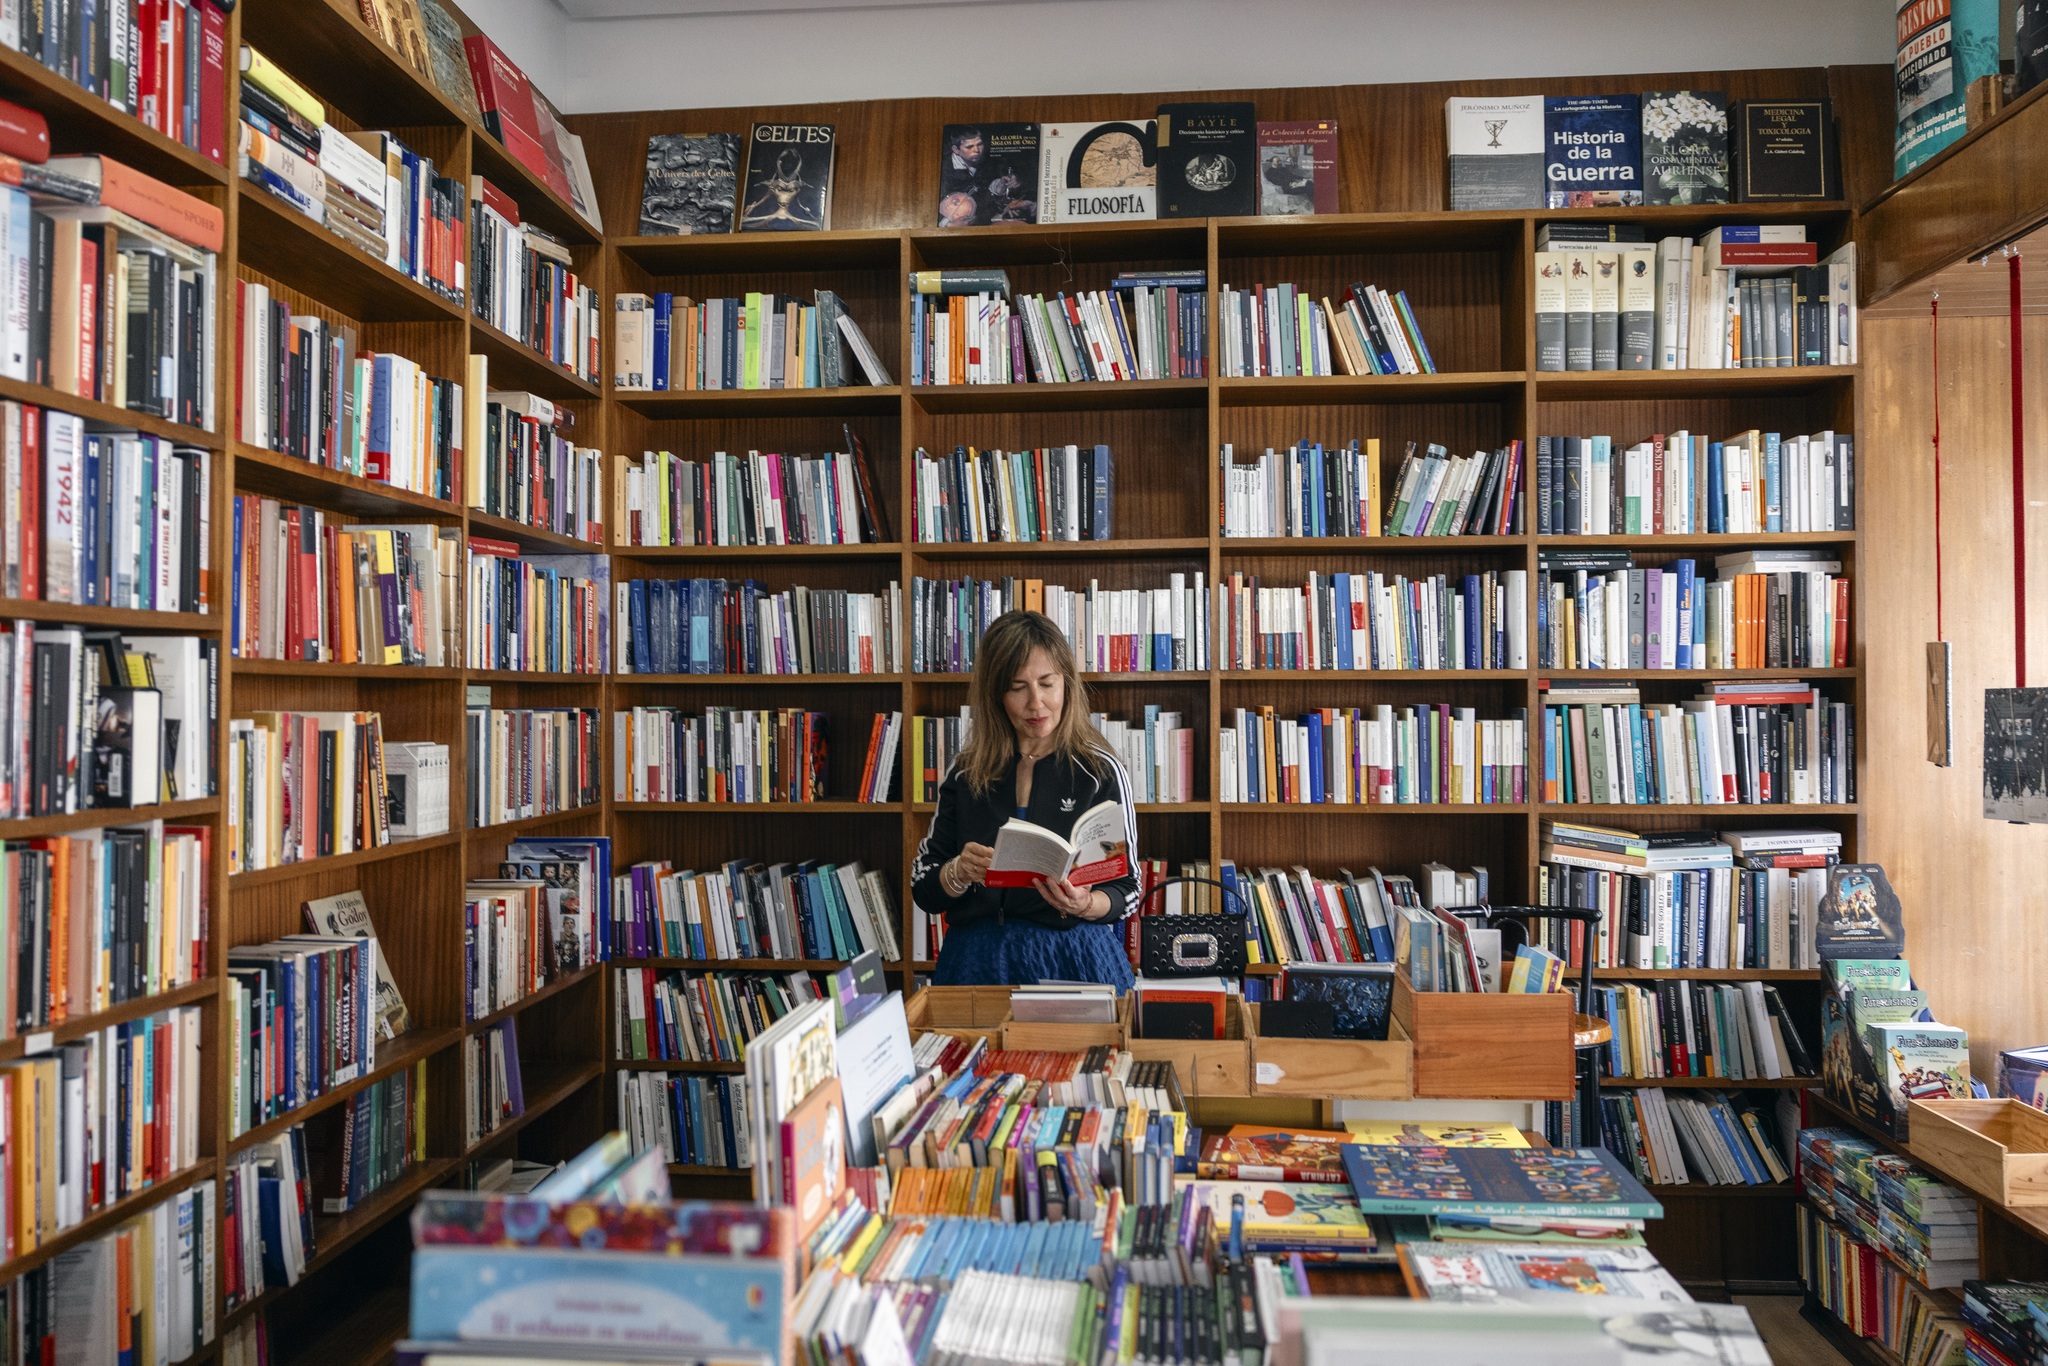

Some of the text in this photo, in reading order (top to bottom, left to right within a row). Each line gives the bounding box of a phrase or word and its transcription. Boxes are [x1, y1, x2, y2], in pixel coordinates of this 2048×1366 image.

[1908, 28, 1946, 58] PUEBLO
[128, 24, 138, 107] LLOYD CLARK
[1898, 47, 1947, 81] TRAICIONADO
[1460, 103, 1531, 112] JERÓNIMO MUÑOZ
[1945, 107, 1957, 119] por
[1957, 103, 1966, 114] el
[1187, 118, 1238, 127] BAYLE
[755, 125, 831, 144] CELTES
[1272, 128, 1305, 136] Colección
[1553, 129, 1625, 145] Historia
[1567, 145, 1612, 159] de la
[1651, 156, 1720, 164] ORNAMENTAL
[1042, 148, 1051, 179] territorio
[1547, 162, 1635, 181] Guerra
[1651, 165, 1720, 176] AURIENSE
[1043, 187, 1050, 195] es
[1042, 196, 1051, 215] mapa
[1067, 193, 1145, 216] FILOSOFÍA
[183, 210, 216, 233] SPOHR
[107, 274, 115, 307] ESPAÑA
[82, 284, 93, 382] Vender a Hitler
[1655, 441, 1663, 471] KUKSO
[57, 462, 73, 525] 1942
[1633, 593, 1641, 604] 2
[1650, 593, 1656, 604] 1
[209, 647, 217, 720] REVOLUCIÓN DICTADURA
[1591, 727, 1600, 739] 4
[1623, 838, 1642, 846] ATLAS
[1561, 857, 1607, 870] MIMETISMO
[1657, 894, 1666, 922] OTROS
[337, 909, 368, 927] Godoy
[1698, 920, 1705, 929] DE
[1698, 929, 1704, 937] LA
[1669, 986, 1677, 1011] CONTAGIO
[342, 982, 351, 1061] GUERRILLA
[1556, 1206, 1630, 1217] LIBRO LETRAS
